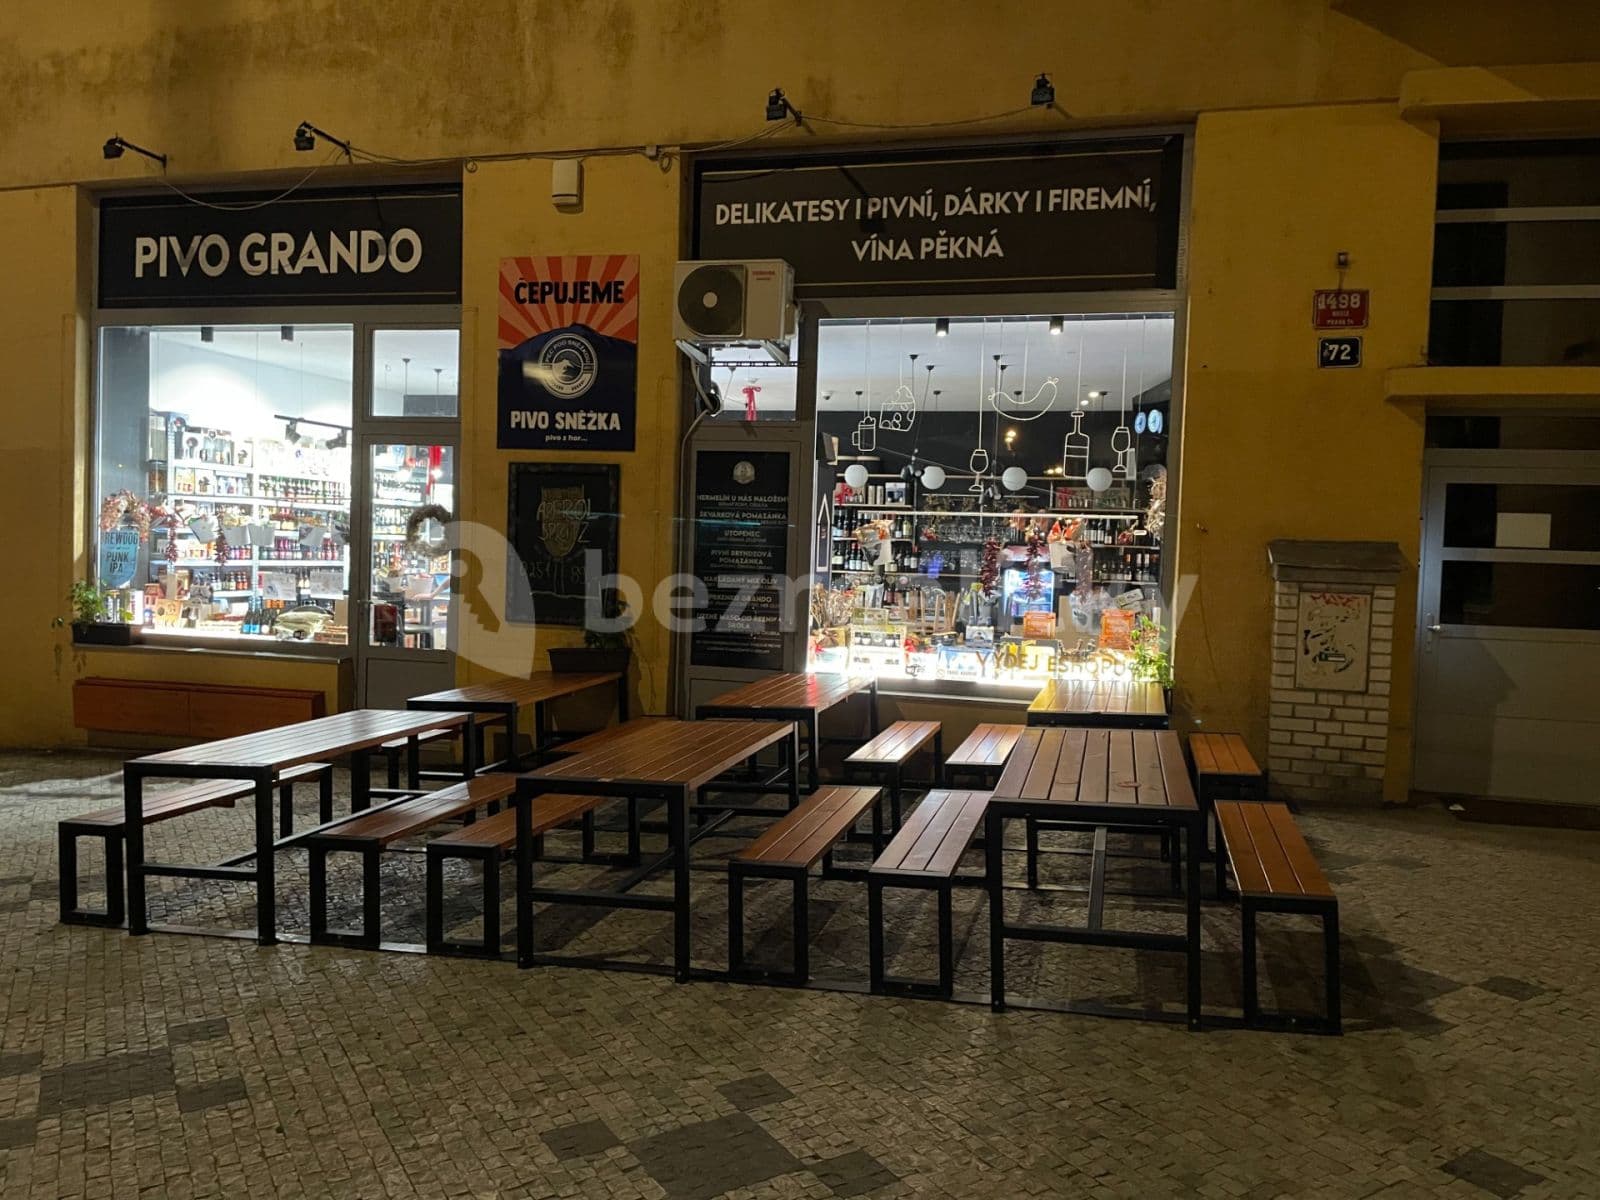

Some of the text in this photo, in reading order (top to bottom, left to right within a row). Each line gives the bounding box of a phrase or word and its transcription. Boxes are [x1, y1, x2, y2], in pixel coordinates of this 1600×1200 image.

[715, 179, 1157, 225] DELIKATESY I PIVNÍ, DÁRKY I FIREMNÍ,
[135, 227, 422, 278] PIVO GRANDO
[852, 229, 1004, 262] VÍNA PĚKNÁ
[514, 277, 625, 304] ČEPUJEME
[1318, 292, 1361, 310] 1498
[1328, 343, 1352, 361] 72
[510, 408, 621, 431] PIVO SNĚŽKA
[544, 433, 561, 442] pivo
[106, 552, 129, 562] PUNK
[110, 562, 123, 573] IPA
